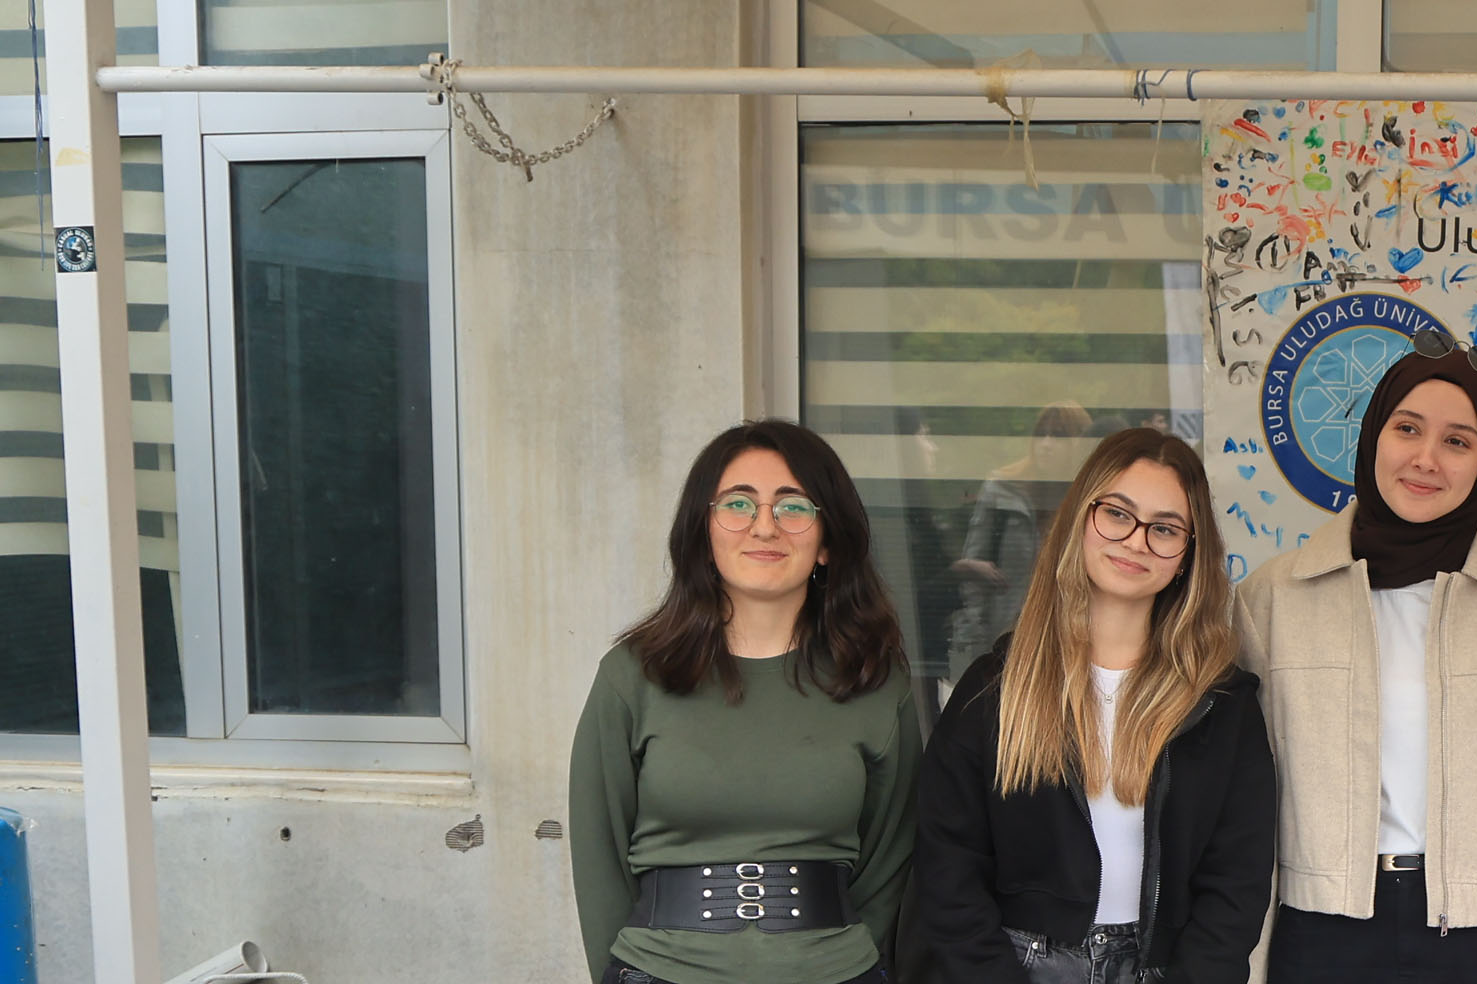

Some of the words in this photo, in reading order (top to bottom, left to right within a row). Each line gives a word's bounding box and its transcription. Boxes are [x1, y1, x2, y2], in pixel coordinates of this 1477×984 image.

[812, 177, 1128, 243] BURSA
[1267, 369, 1289, 446] BURSA
[1280, 297, 1365, 361] ULUDAĞ
